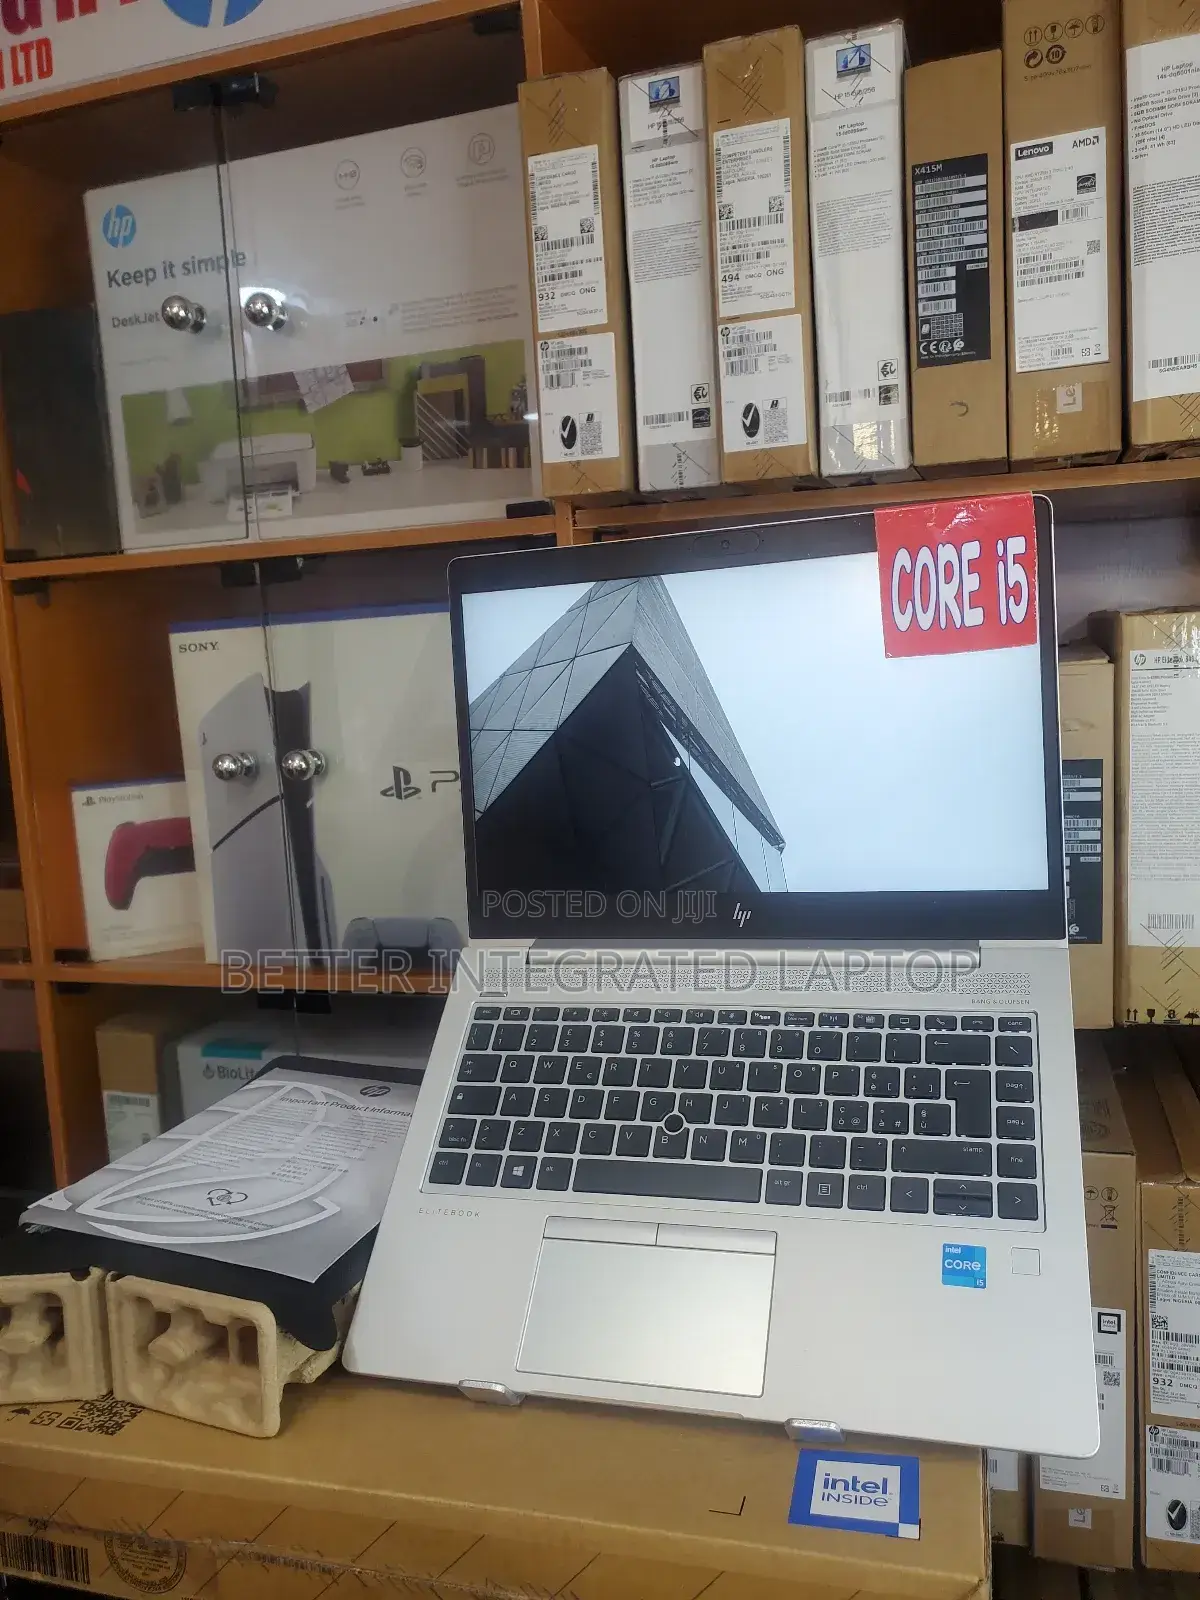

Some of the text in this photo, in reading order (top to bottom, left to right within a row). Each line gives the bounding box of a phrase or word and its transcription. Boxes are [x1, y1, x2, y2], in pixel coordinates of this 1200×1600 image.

[11, 37, 53, 86] LTD
[1050, 50, 1060, 60] 10
[1172, 62, 1193, 70] Laptop
[1018, 138, 1092, 157] Lenovo AMD
[915, 164, 942, 175] X415M
[103, 205, 136, 248] hp
[107, 249, 247, 288] Keep it simple
[722, 273, 740, 283] 494
[766, 268, 784, 276] ONG
[538, 292, 556, 302] 932
[579, 286, 596, 294] ONG
[112, 312, 160, 329] DeskJet
[892, 535, 1030, 632] CORE i5
[178, 642, 220, 654] SONY
[732, 902, 752, 928] hp
[217, 1064, 256, 1080] BioLit
[280, 1097, 329, 1107] Important
[330, 1102, 370, 1112] Product
[723, 1101, 728, 1109] J
[762, 1103, 768, 1111] K
[801, 1105, 806, 1113] L
[739, 1138, 747, 1146] M
[418, 1207, 481, 1218] ELITEBOOK
[945, 1246, 961, 1254] intel
[1152, 1378, 1172, 1387] 932
[823, 1473, 888, 1495] intel
